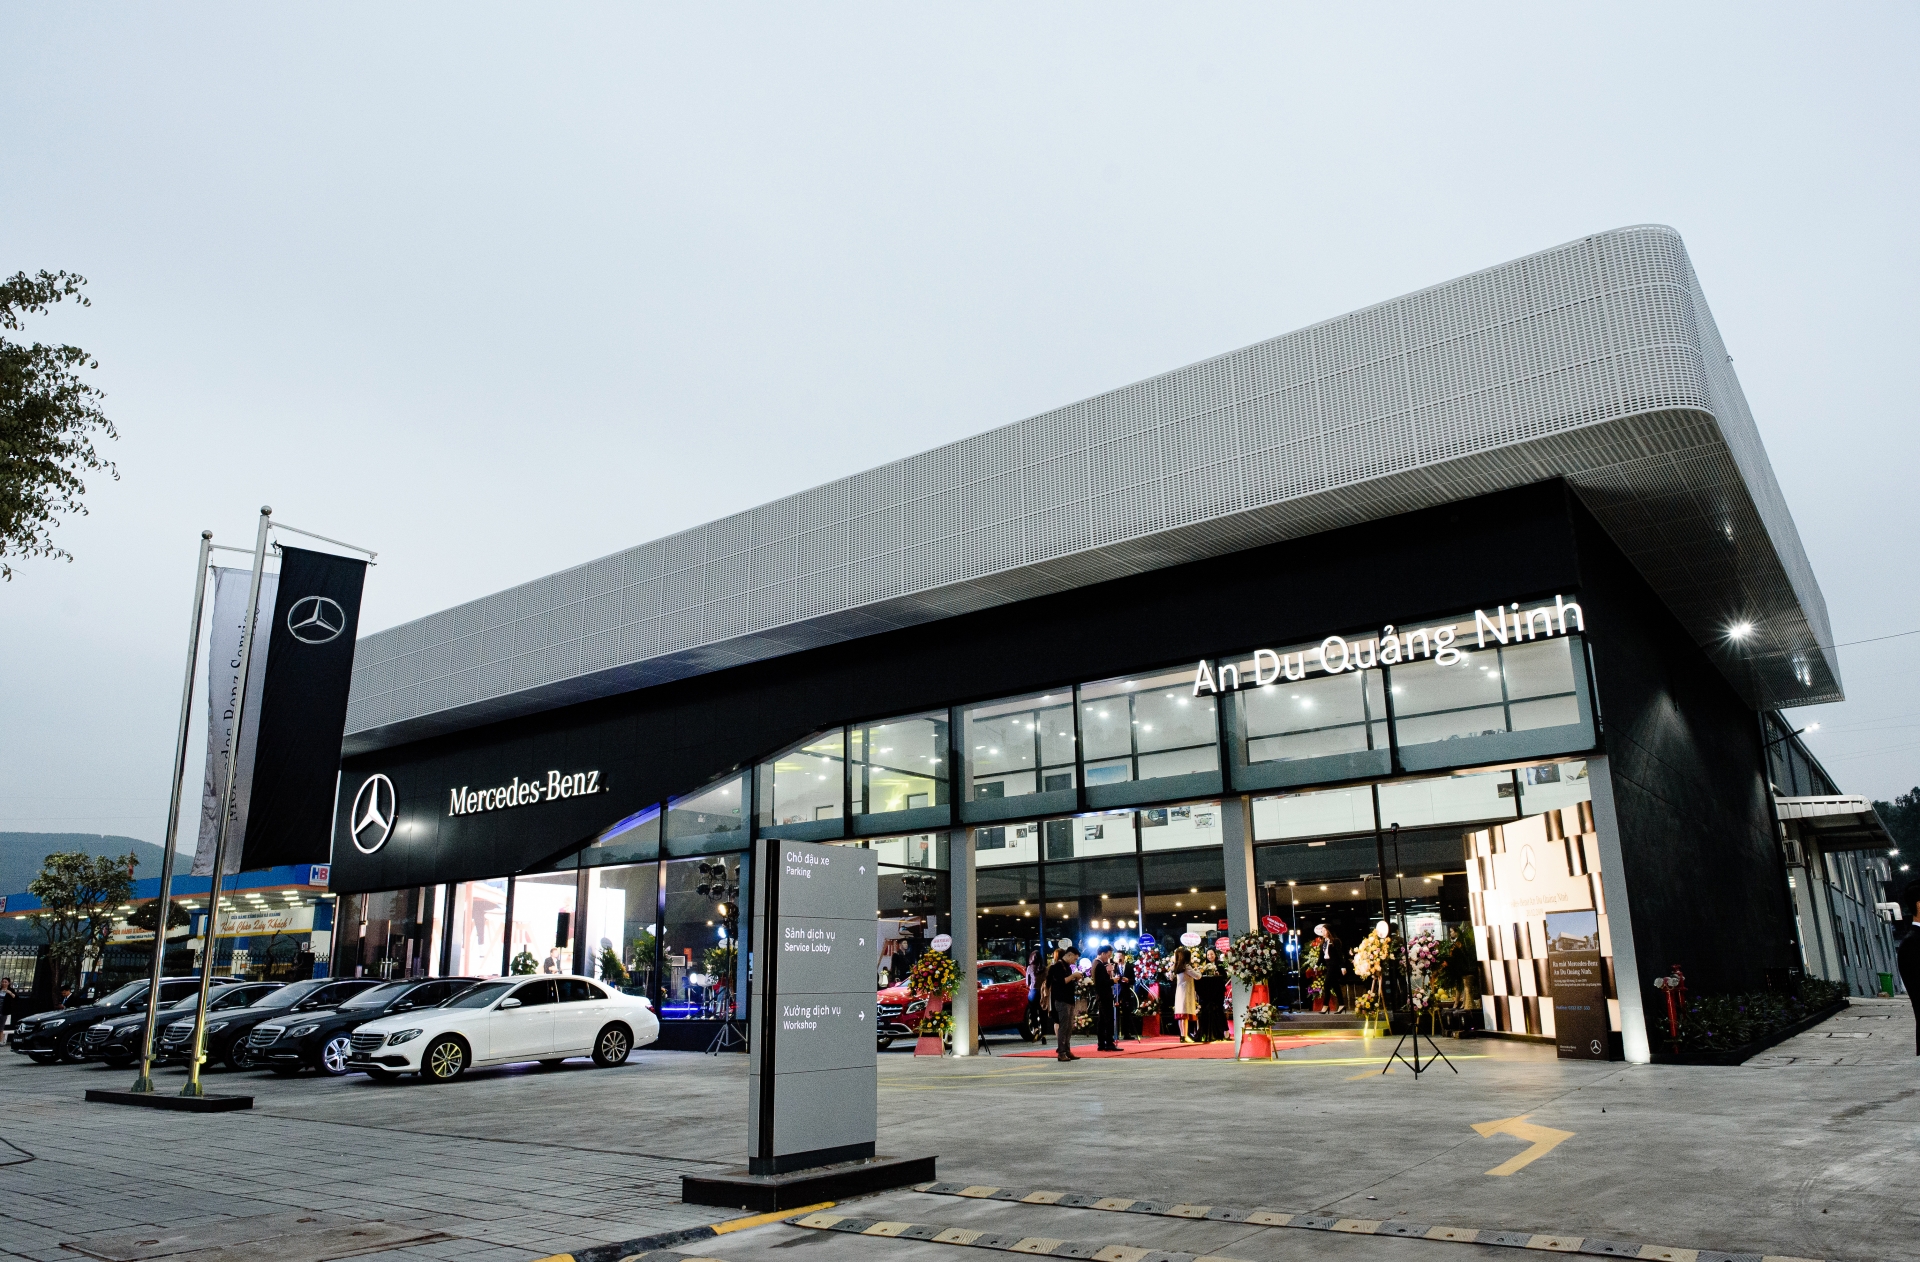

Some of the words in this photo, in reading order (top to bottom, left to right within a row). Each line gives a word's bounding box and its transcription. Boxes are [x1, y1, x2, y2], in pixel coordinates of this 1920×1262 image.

[1193, 659, 1239, 697] An
[1253, 649, 1306, 686] Du
[1320, 624, 1462, 674] Quảng
[1475, 594, 1586, 648] Ninh
[448, 770, 600, 817] Mercedes-Benz
[804, 853, 819, 867] đậu
[820, 857, 830, 866] xe
[312, 867, 328, 881] HB
[786, 864, 812, 879] Parking
[806, 928, 825, 942] dịch
[826, 931, 836, 942] vụ
[784, 942, 810, 952] Service
[811, 943, 831, 955] Lobby
[812, 1005, 830, 1018] dịch
[831, 1006, 841, 1017] vụ
[783, 1019, 817, 1031] Workshop
